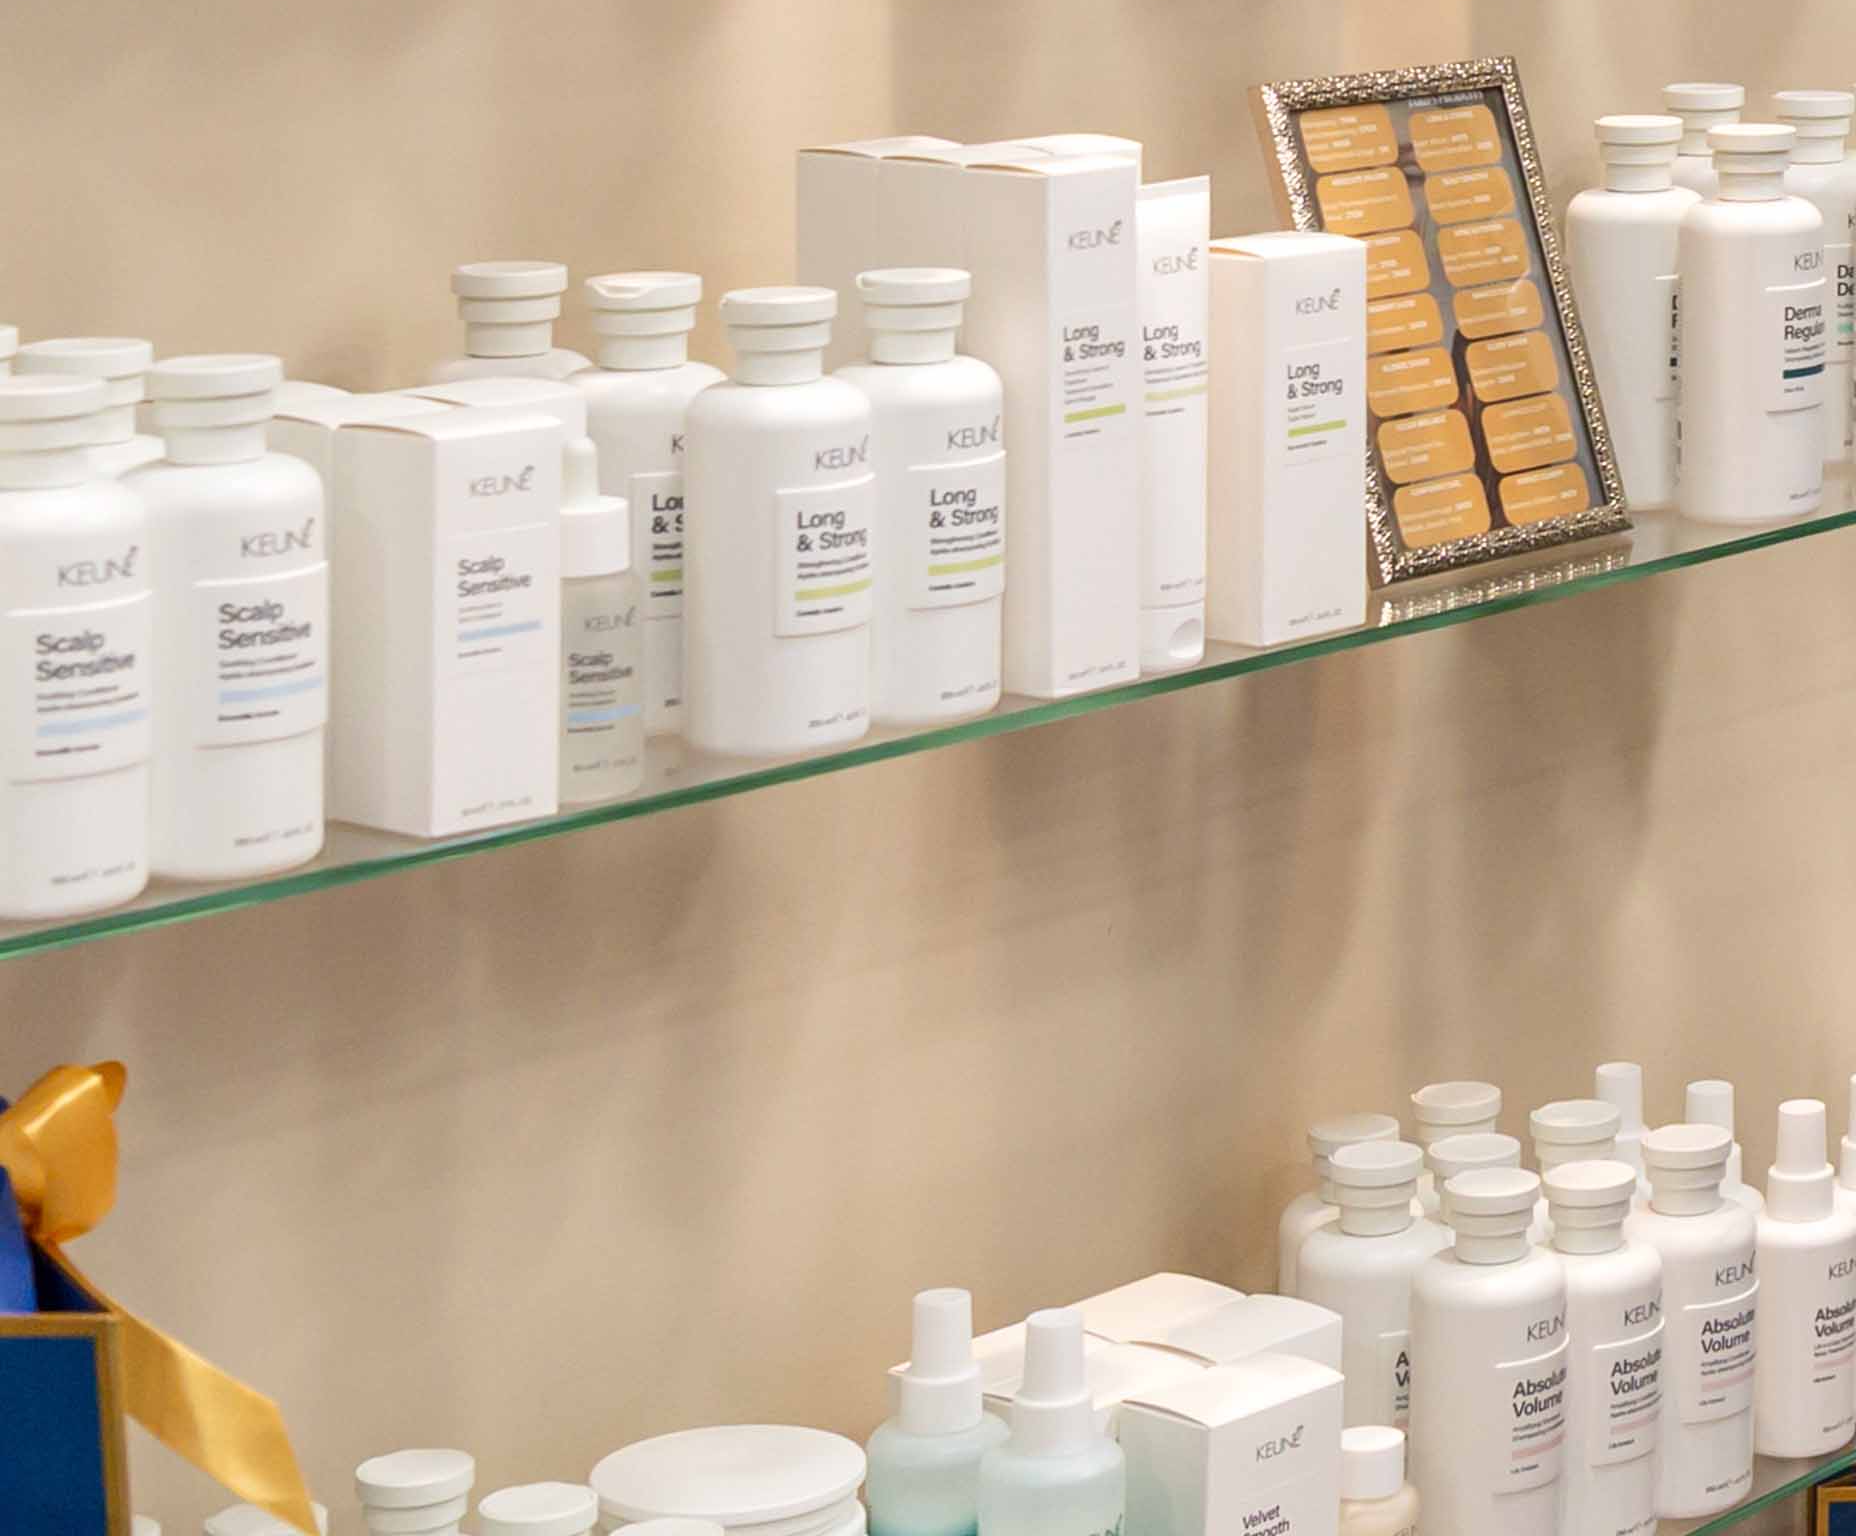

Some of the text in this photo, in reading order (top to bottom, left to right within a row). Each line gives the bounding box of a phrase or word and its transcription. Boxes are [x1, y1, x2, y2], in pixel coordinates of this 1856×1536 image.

[1063, 324, 1099, 345] Long
[1143, 324, 1179, 345] Long
[1063, 339, 1125, 362] & Strong
[1143, 338, 1201, 361] & Strong
[1287, 362, 1320, 382] Long
[1287, 379, 1343, 399] & Strong
[930, 488, 976, 508] Long
[797, 510, 845, 532] Long
[930, 512, 945, 527] &
[797, 535, 813, 552] &
[458, 554, 505, 576] Scalp
[458, 573, 532, 598] Sensitive
[219, 600, 283, 624] Scalp
[36, 630, 104, 655] Scalp
[569, 651, 613, 668] Scalp
[1701, 1330, 1751, 1354] Volume
[1611, 1370, 1658, 1396] Volume
[1242, 1505, 1280, 1530] Velvet
